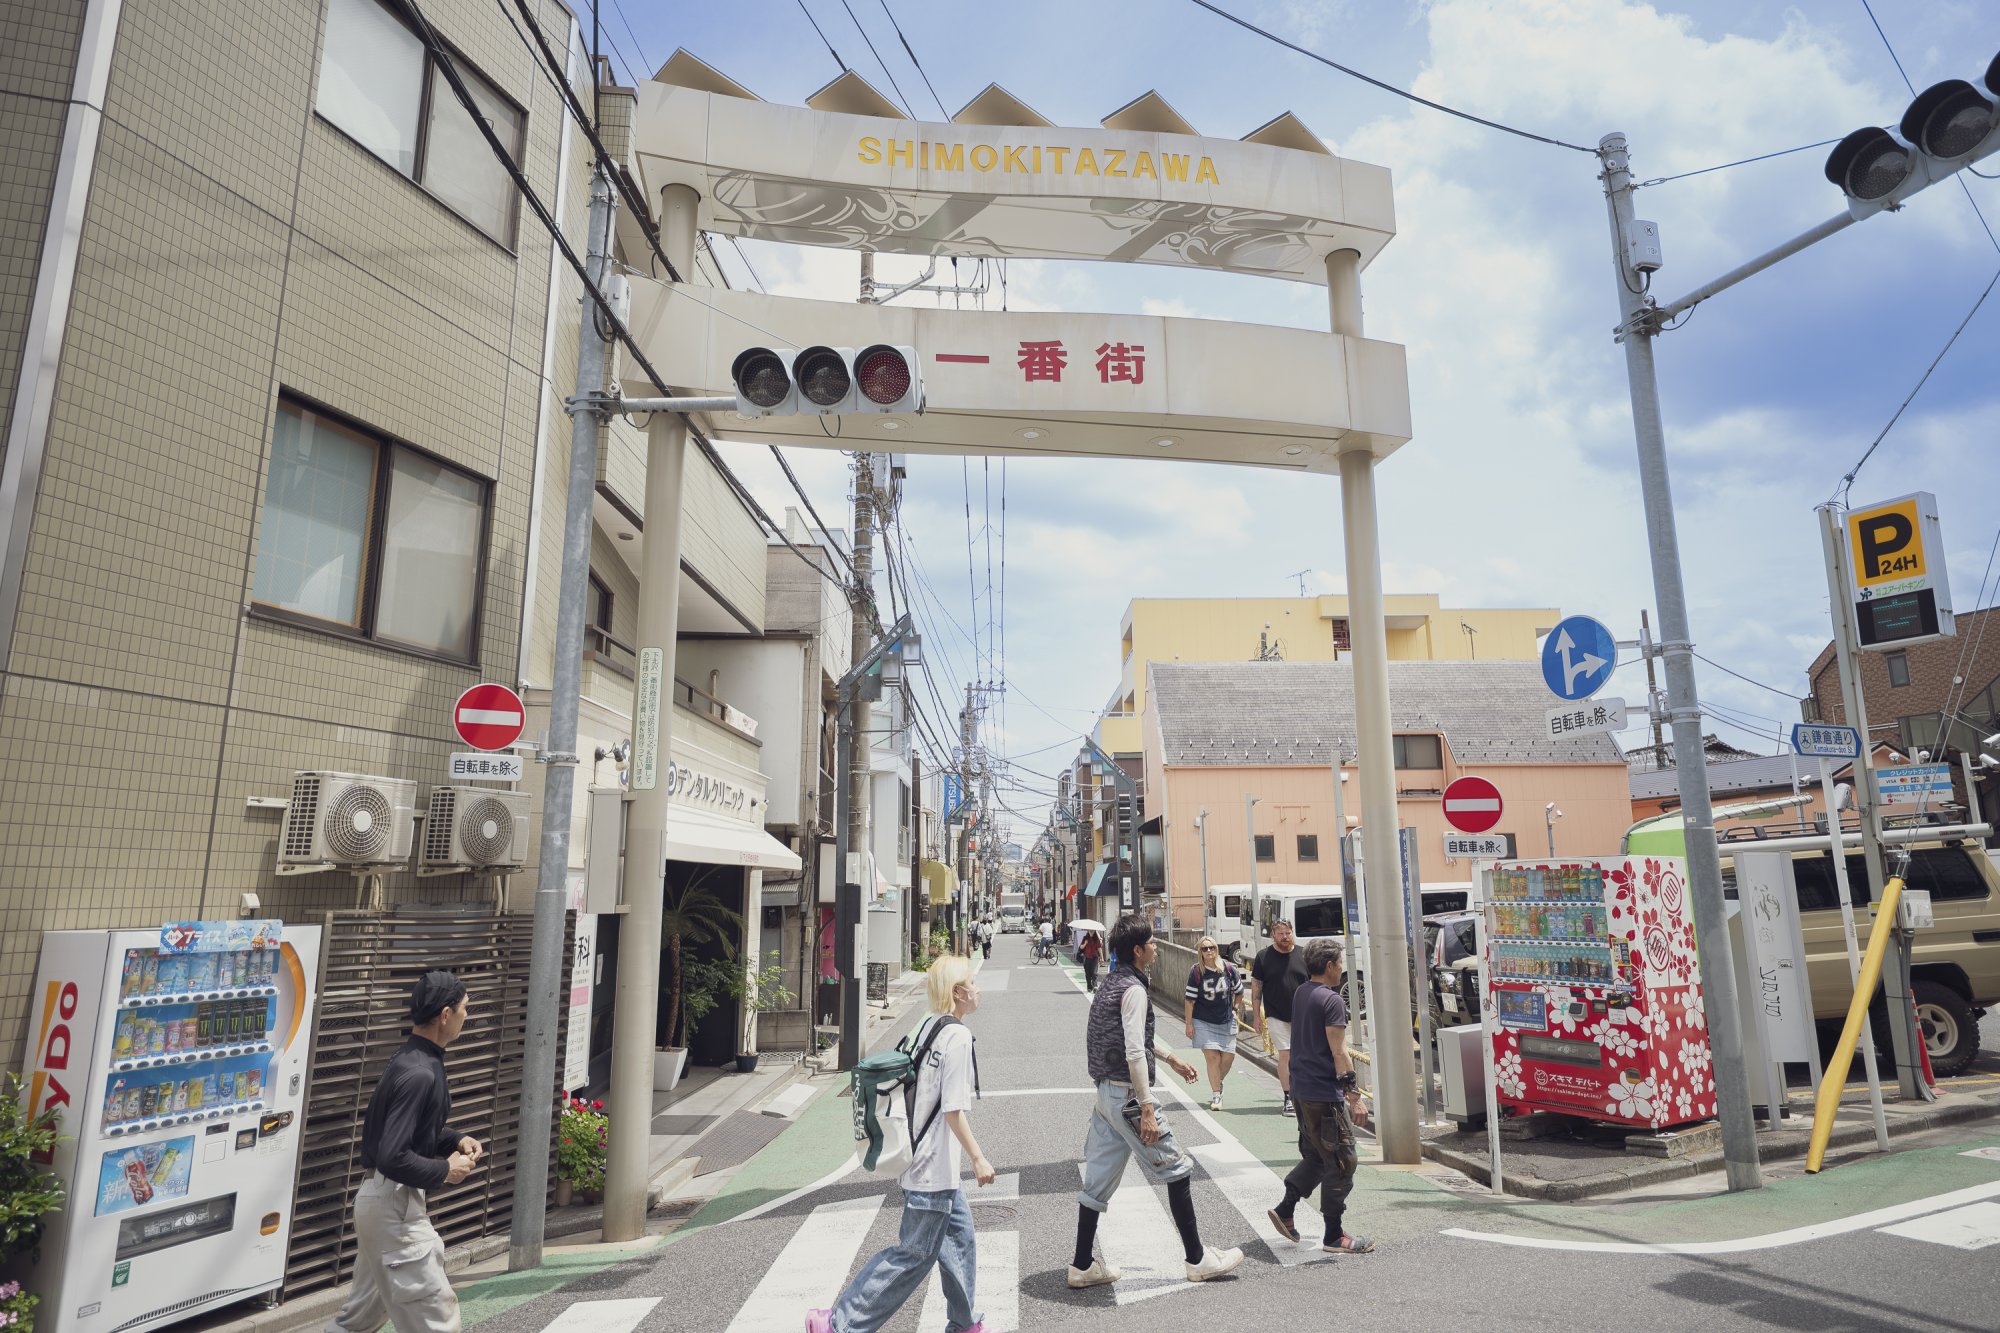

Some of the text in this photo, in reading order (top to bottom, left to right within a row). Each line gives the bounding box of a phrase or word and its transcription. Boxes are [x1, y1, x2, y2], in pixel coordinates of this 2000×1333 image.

[857, 136, 1220, 185] SHIMOKITAZAWA
[935, 340, 1146, 384] 一番街
[1858, 513, 1912, 578] P
[1881, 554, 1917, 575] 24H
[1551, 706, 1618, 735] 自転車を除く
[1811, 730, 1853, 745] 鎌倉通り
[454, 759, 519, 776] 自転車を除く
[678, 768, 744, 811] デンタルクリニック
[1448, 840, 1502, 853] 自転車を除く
[573, 934, 591, 969] 科
[1203, 976, 1228, 1000] 54
[1549, 1073, 1602, 1088] スキマ デパート
